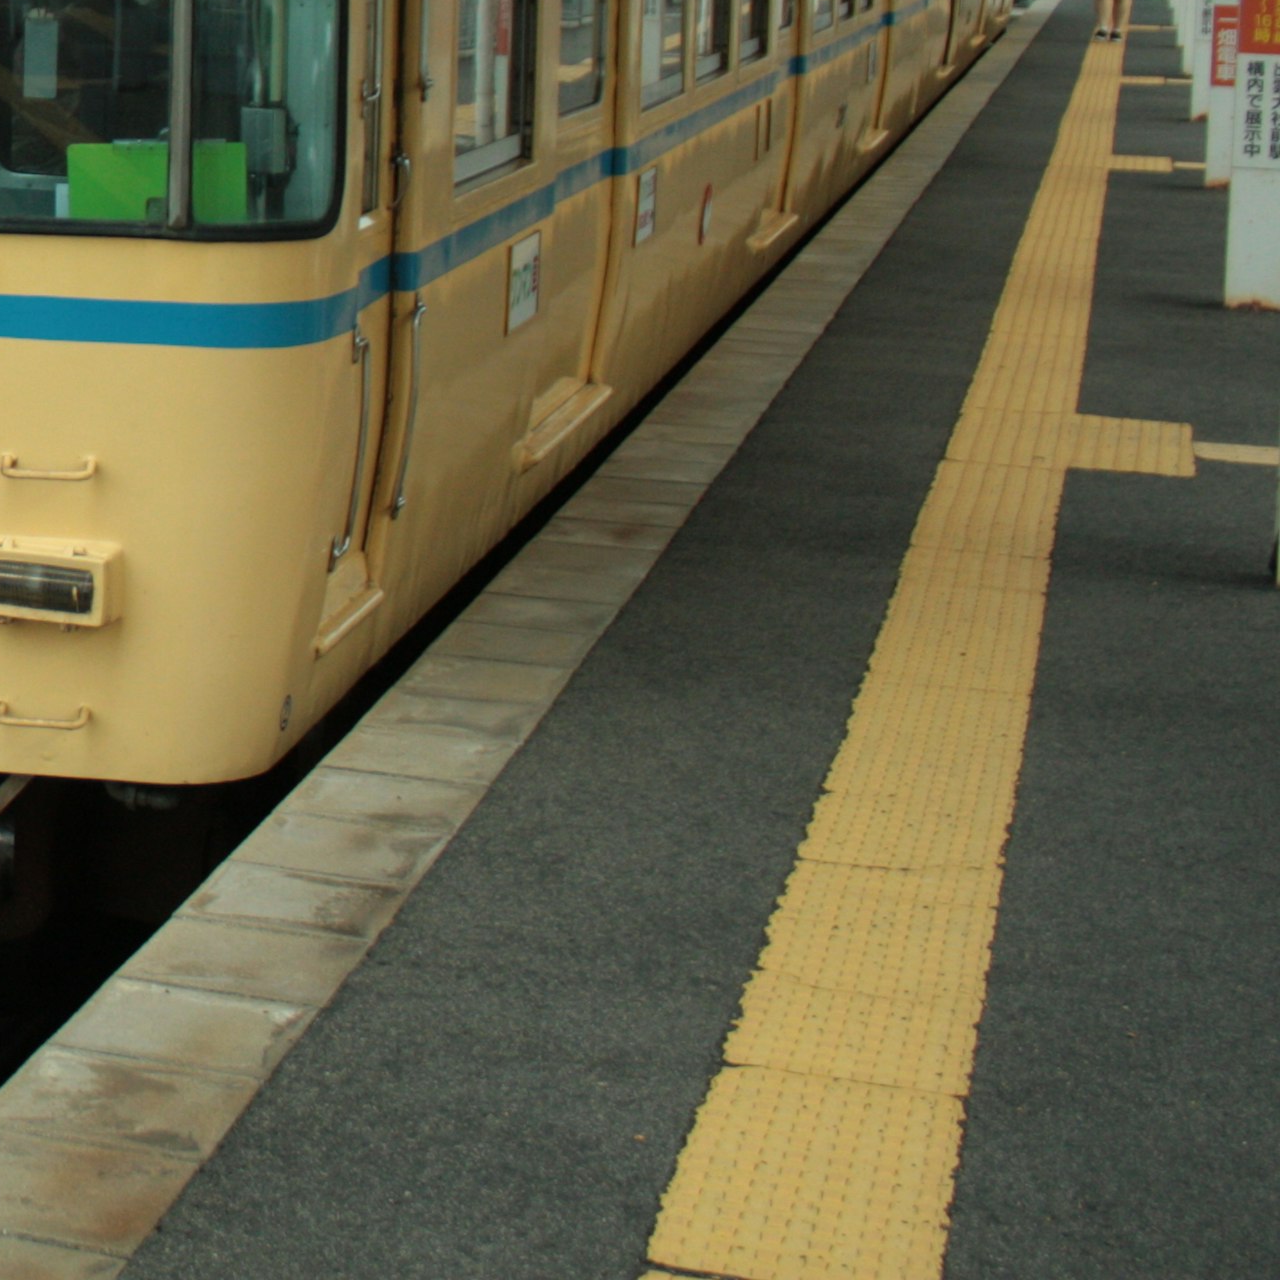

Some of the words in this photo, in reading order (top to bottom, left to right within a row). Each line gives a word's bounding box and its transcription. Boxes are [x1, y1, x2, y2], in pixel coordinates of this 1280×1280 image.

[1243, 61, 1265, 158] 構内で展示中
